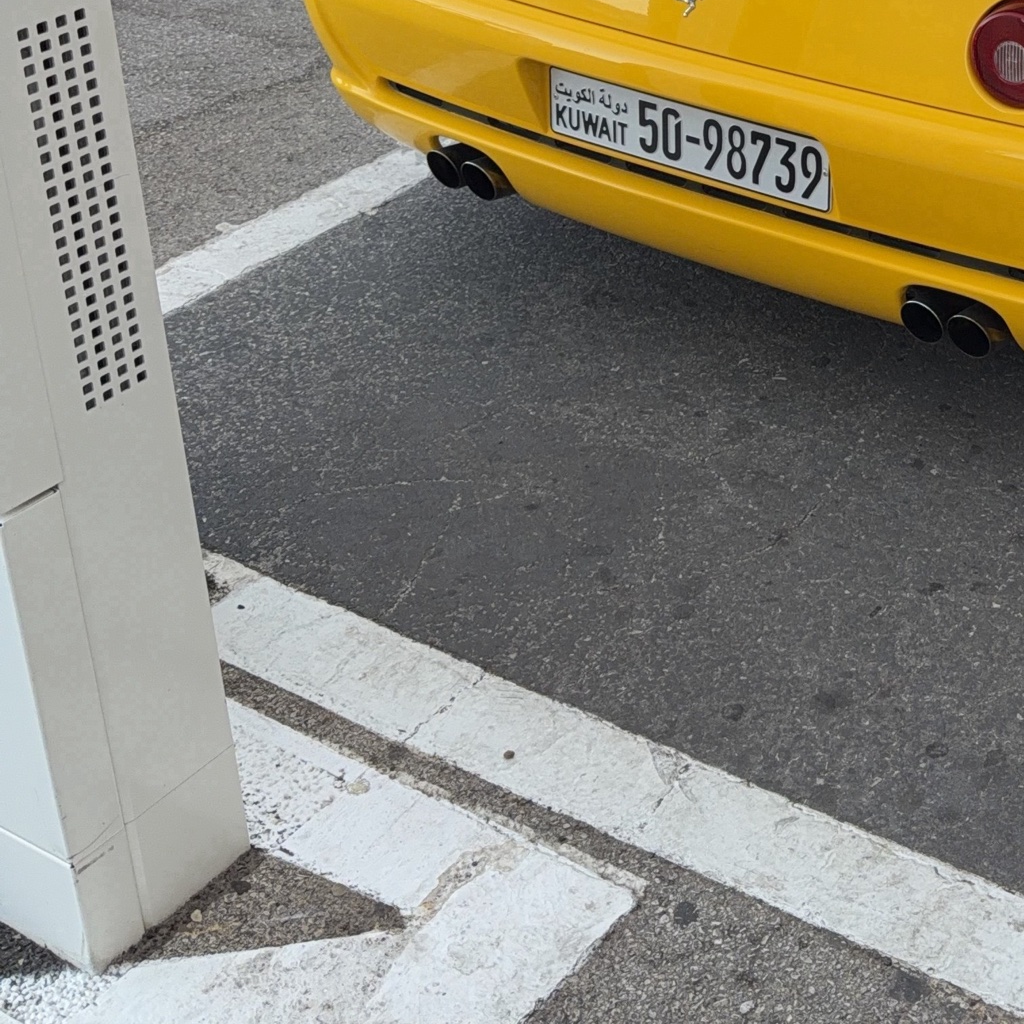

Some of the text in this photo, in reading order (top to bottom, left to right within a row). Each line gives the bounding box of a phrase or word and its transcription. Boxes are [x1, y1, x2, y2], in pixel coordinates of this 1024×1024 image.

[555, 82, 628, 116] دولة الكويت
[555, 103, 628, 146] KUWAIT
[638, 99, 822, 200] 50-98739
